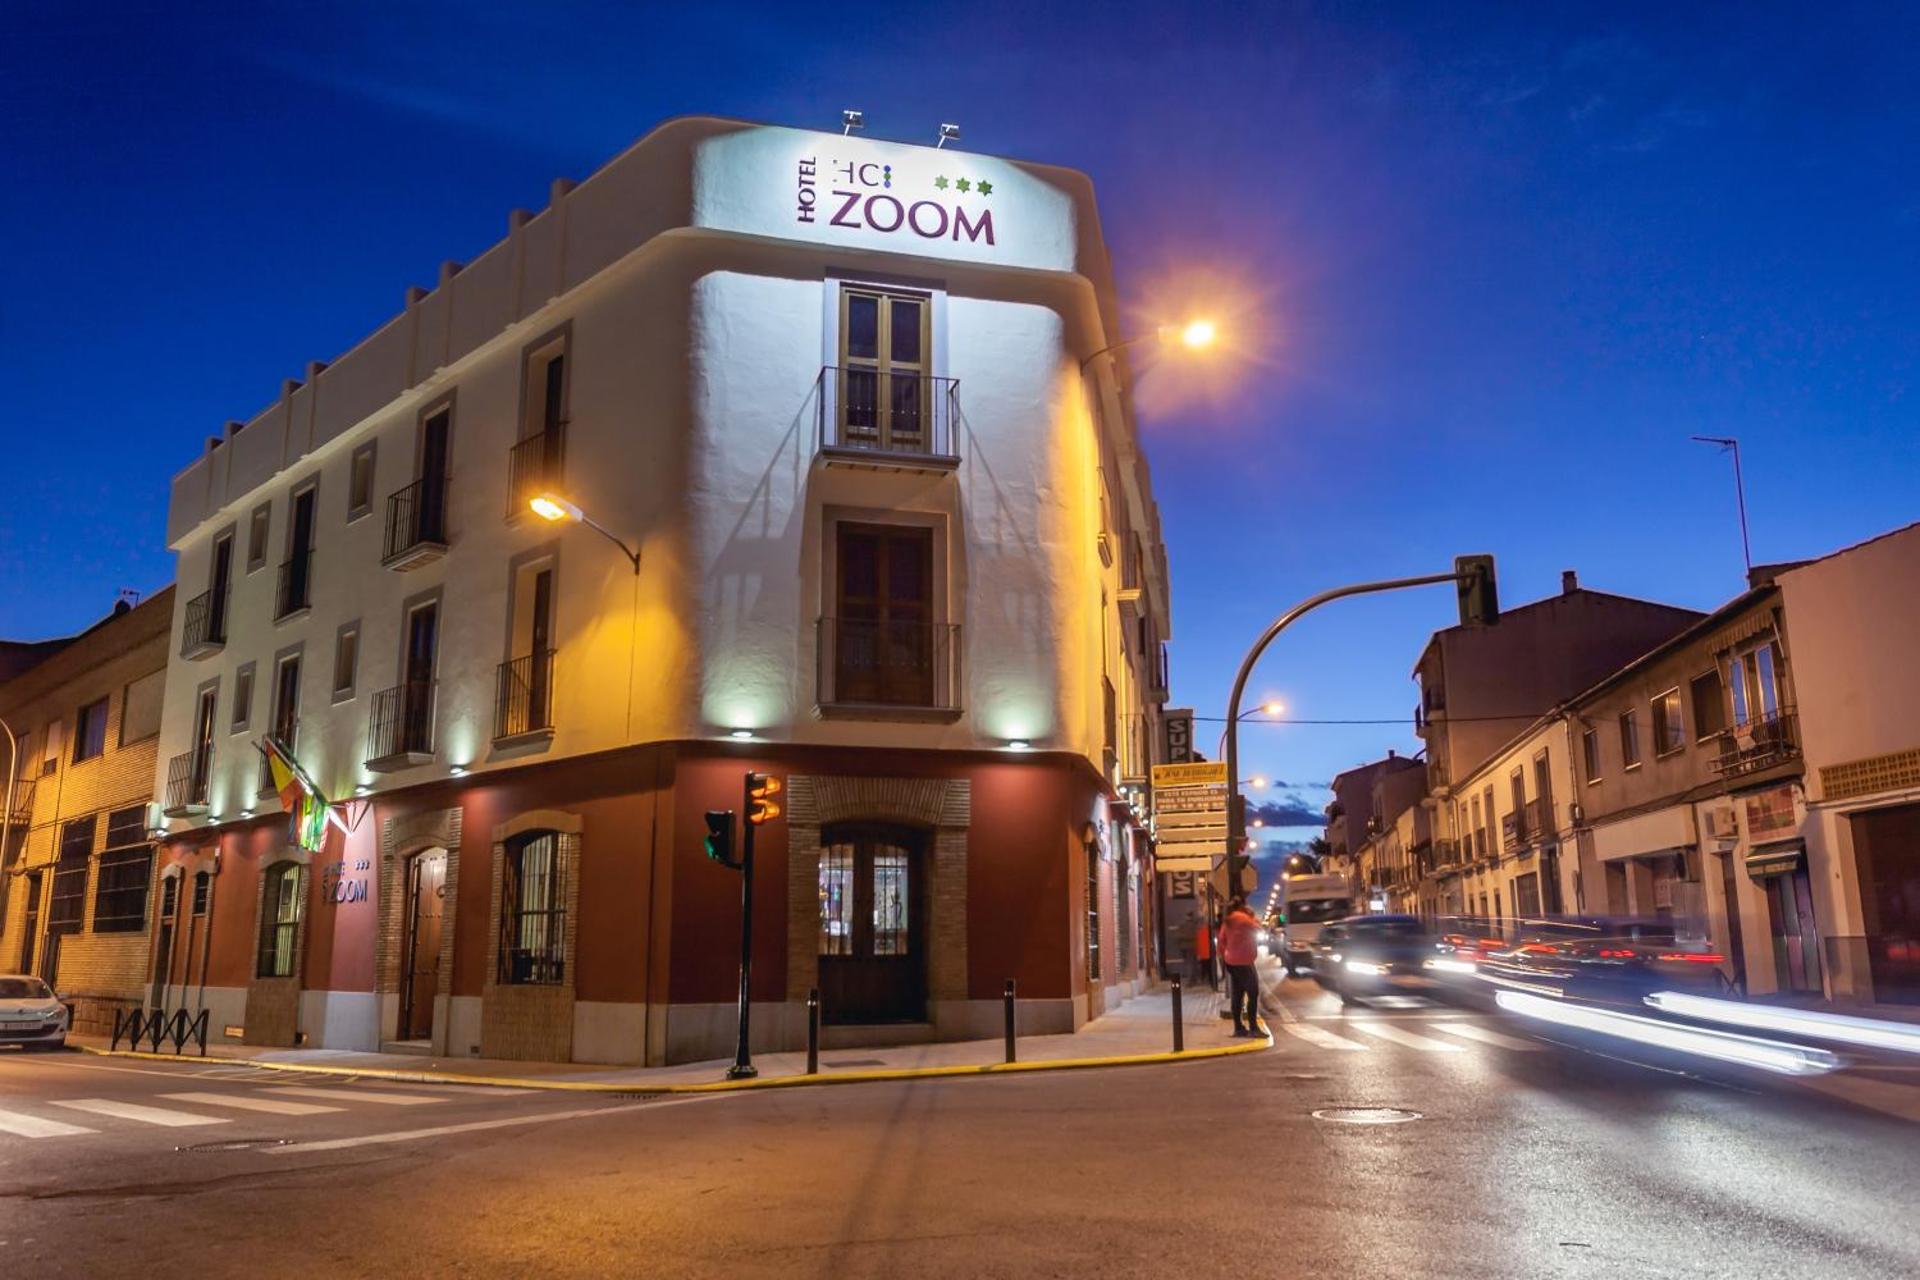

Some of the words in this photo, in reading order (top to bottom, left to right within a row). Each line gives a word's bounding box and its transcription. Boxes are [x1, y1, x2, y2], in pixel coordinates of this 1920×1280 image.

[797, 156, 816, 223] HOTEL
[829, 190, 995, 246] ZOOM
[1169, 719, 1188, 762] SUP
